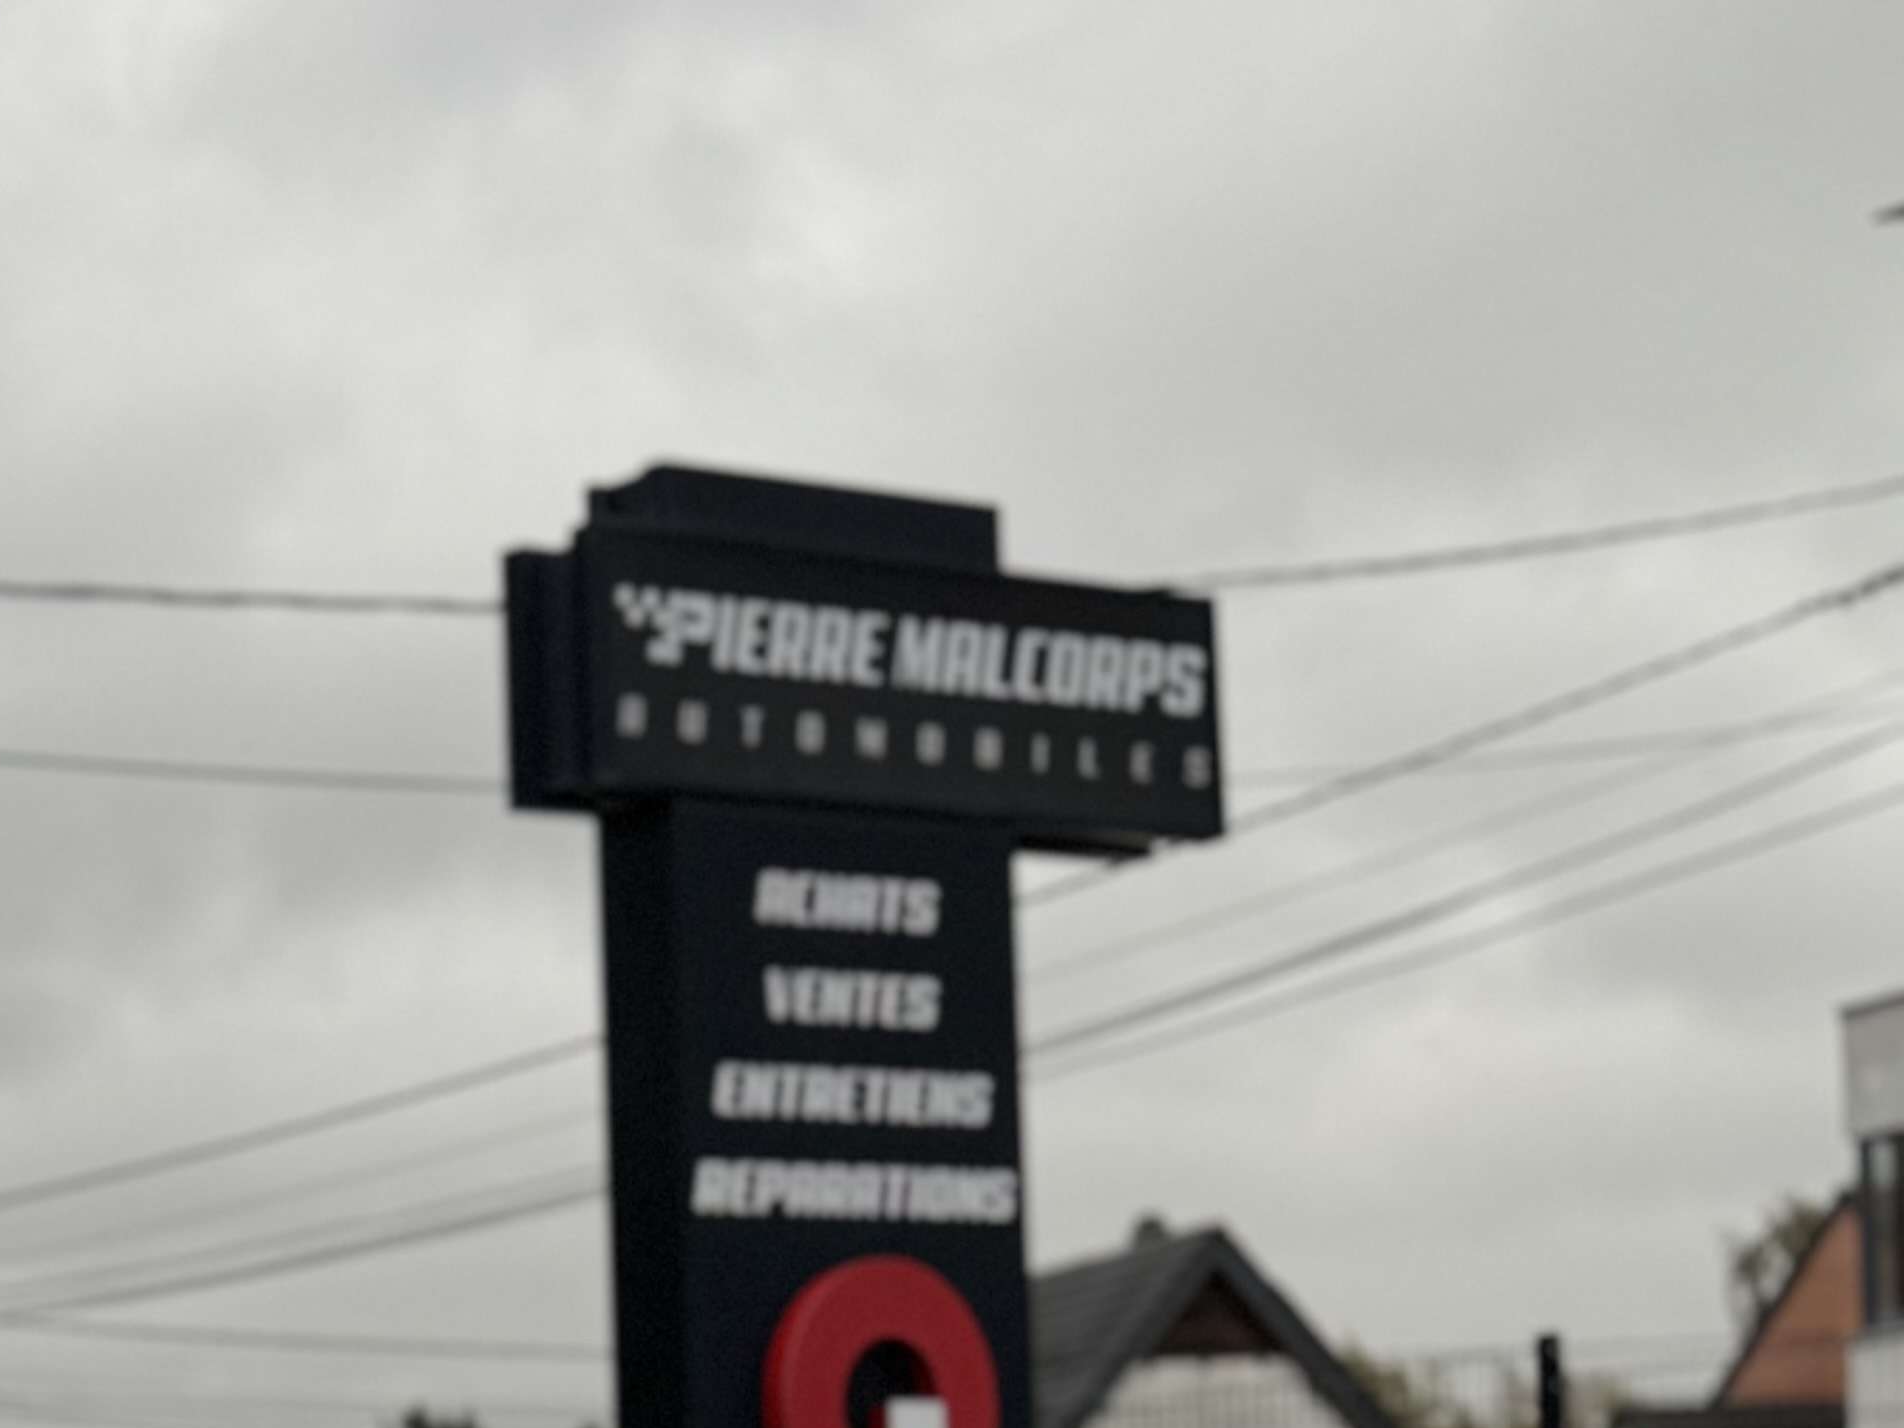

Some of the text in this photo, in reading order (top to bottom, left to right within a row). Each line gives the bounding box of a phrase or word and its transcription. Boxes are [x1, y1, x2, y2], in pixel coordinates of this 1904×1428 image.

[646, 590, 1208, 718] PIERRE MALCORPS
[616, 692, 1213, 788] AUTOMOBILES
[753, 867, 942, 936] ACHATS
[763, 964, 944, 1034] VENTES
[711, 1060, 995, 1129] ENTRETIENS
